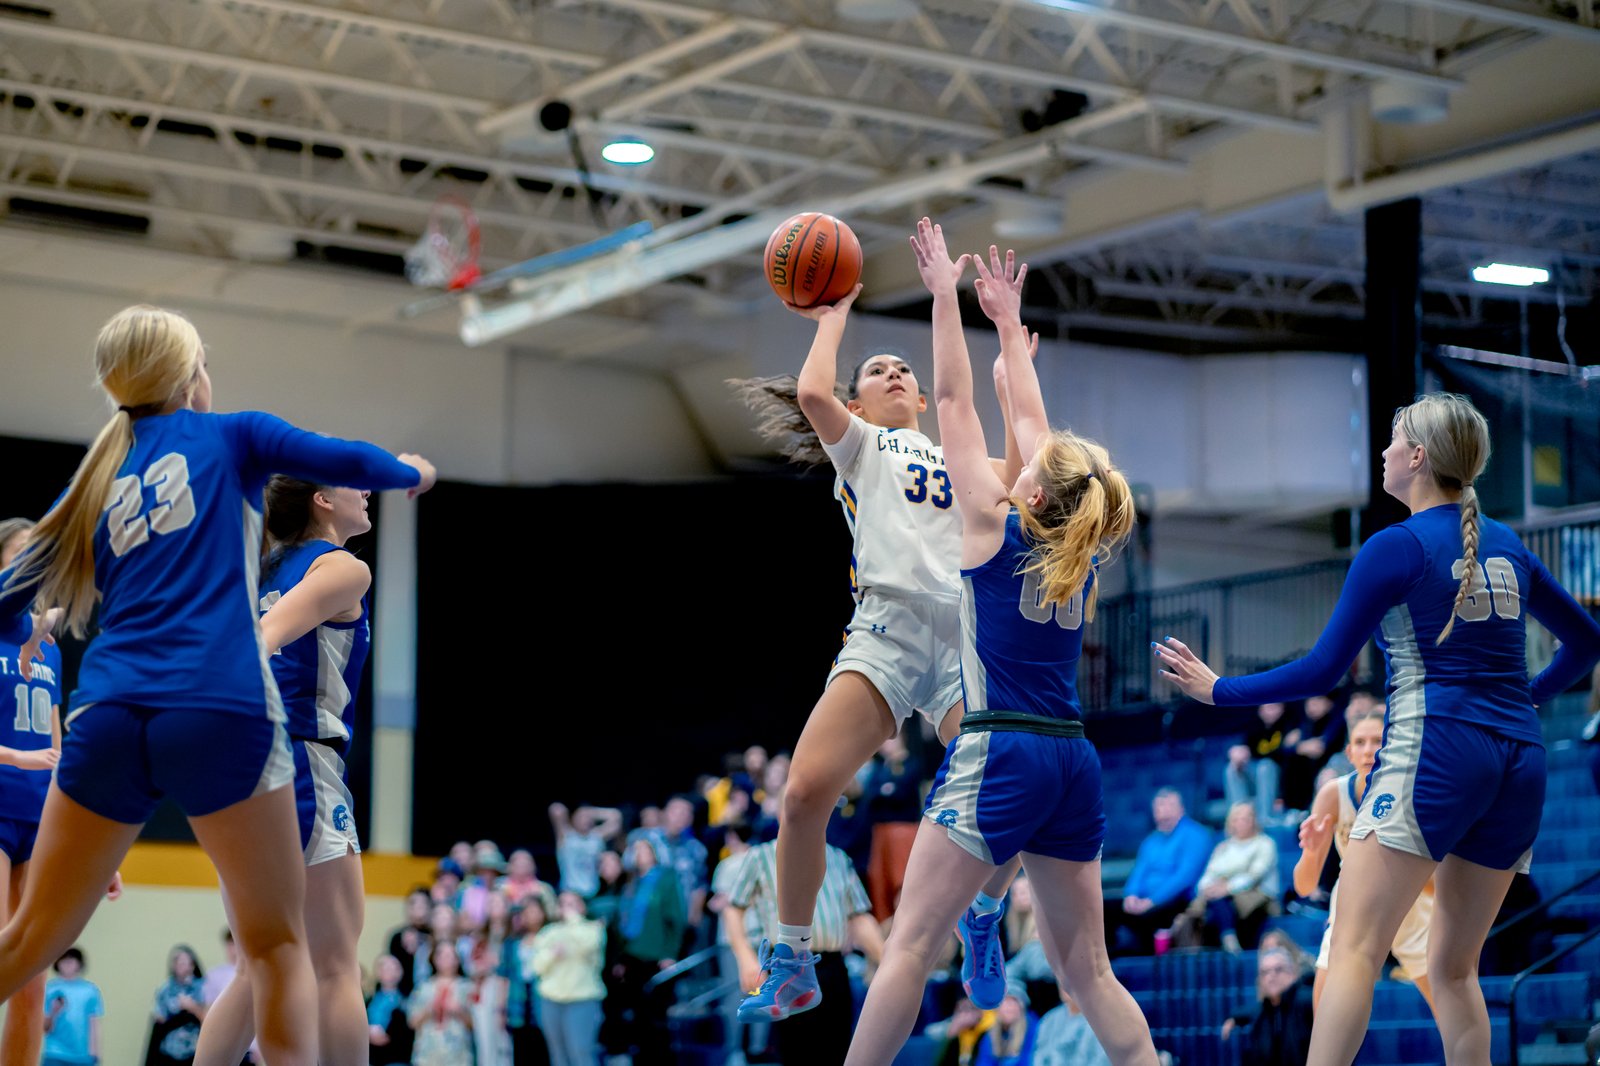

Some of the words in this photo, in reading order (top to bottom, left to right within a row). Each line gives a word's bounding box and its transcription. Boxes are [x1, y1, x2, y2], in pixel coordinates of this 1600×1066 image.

[774, 223, 804, 286] Wilson
[802, 231, 828, 291] EVOLUTION
[103, 452, 196, 557] 23
[904, 463, 953, 510] 33
[1451, 556, 1521, 622] 30
[14, 683, 52, 735] 10
